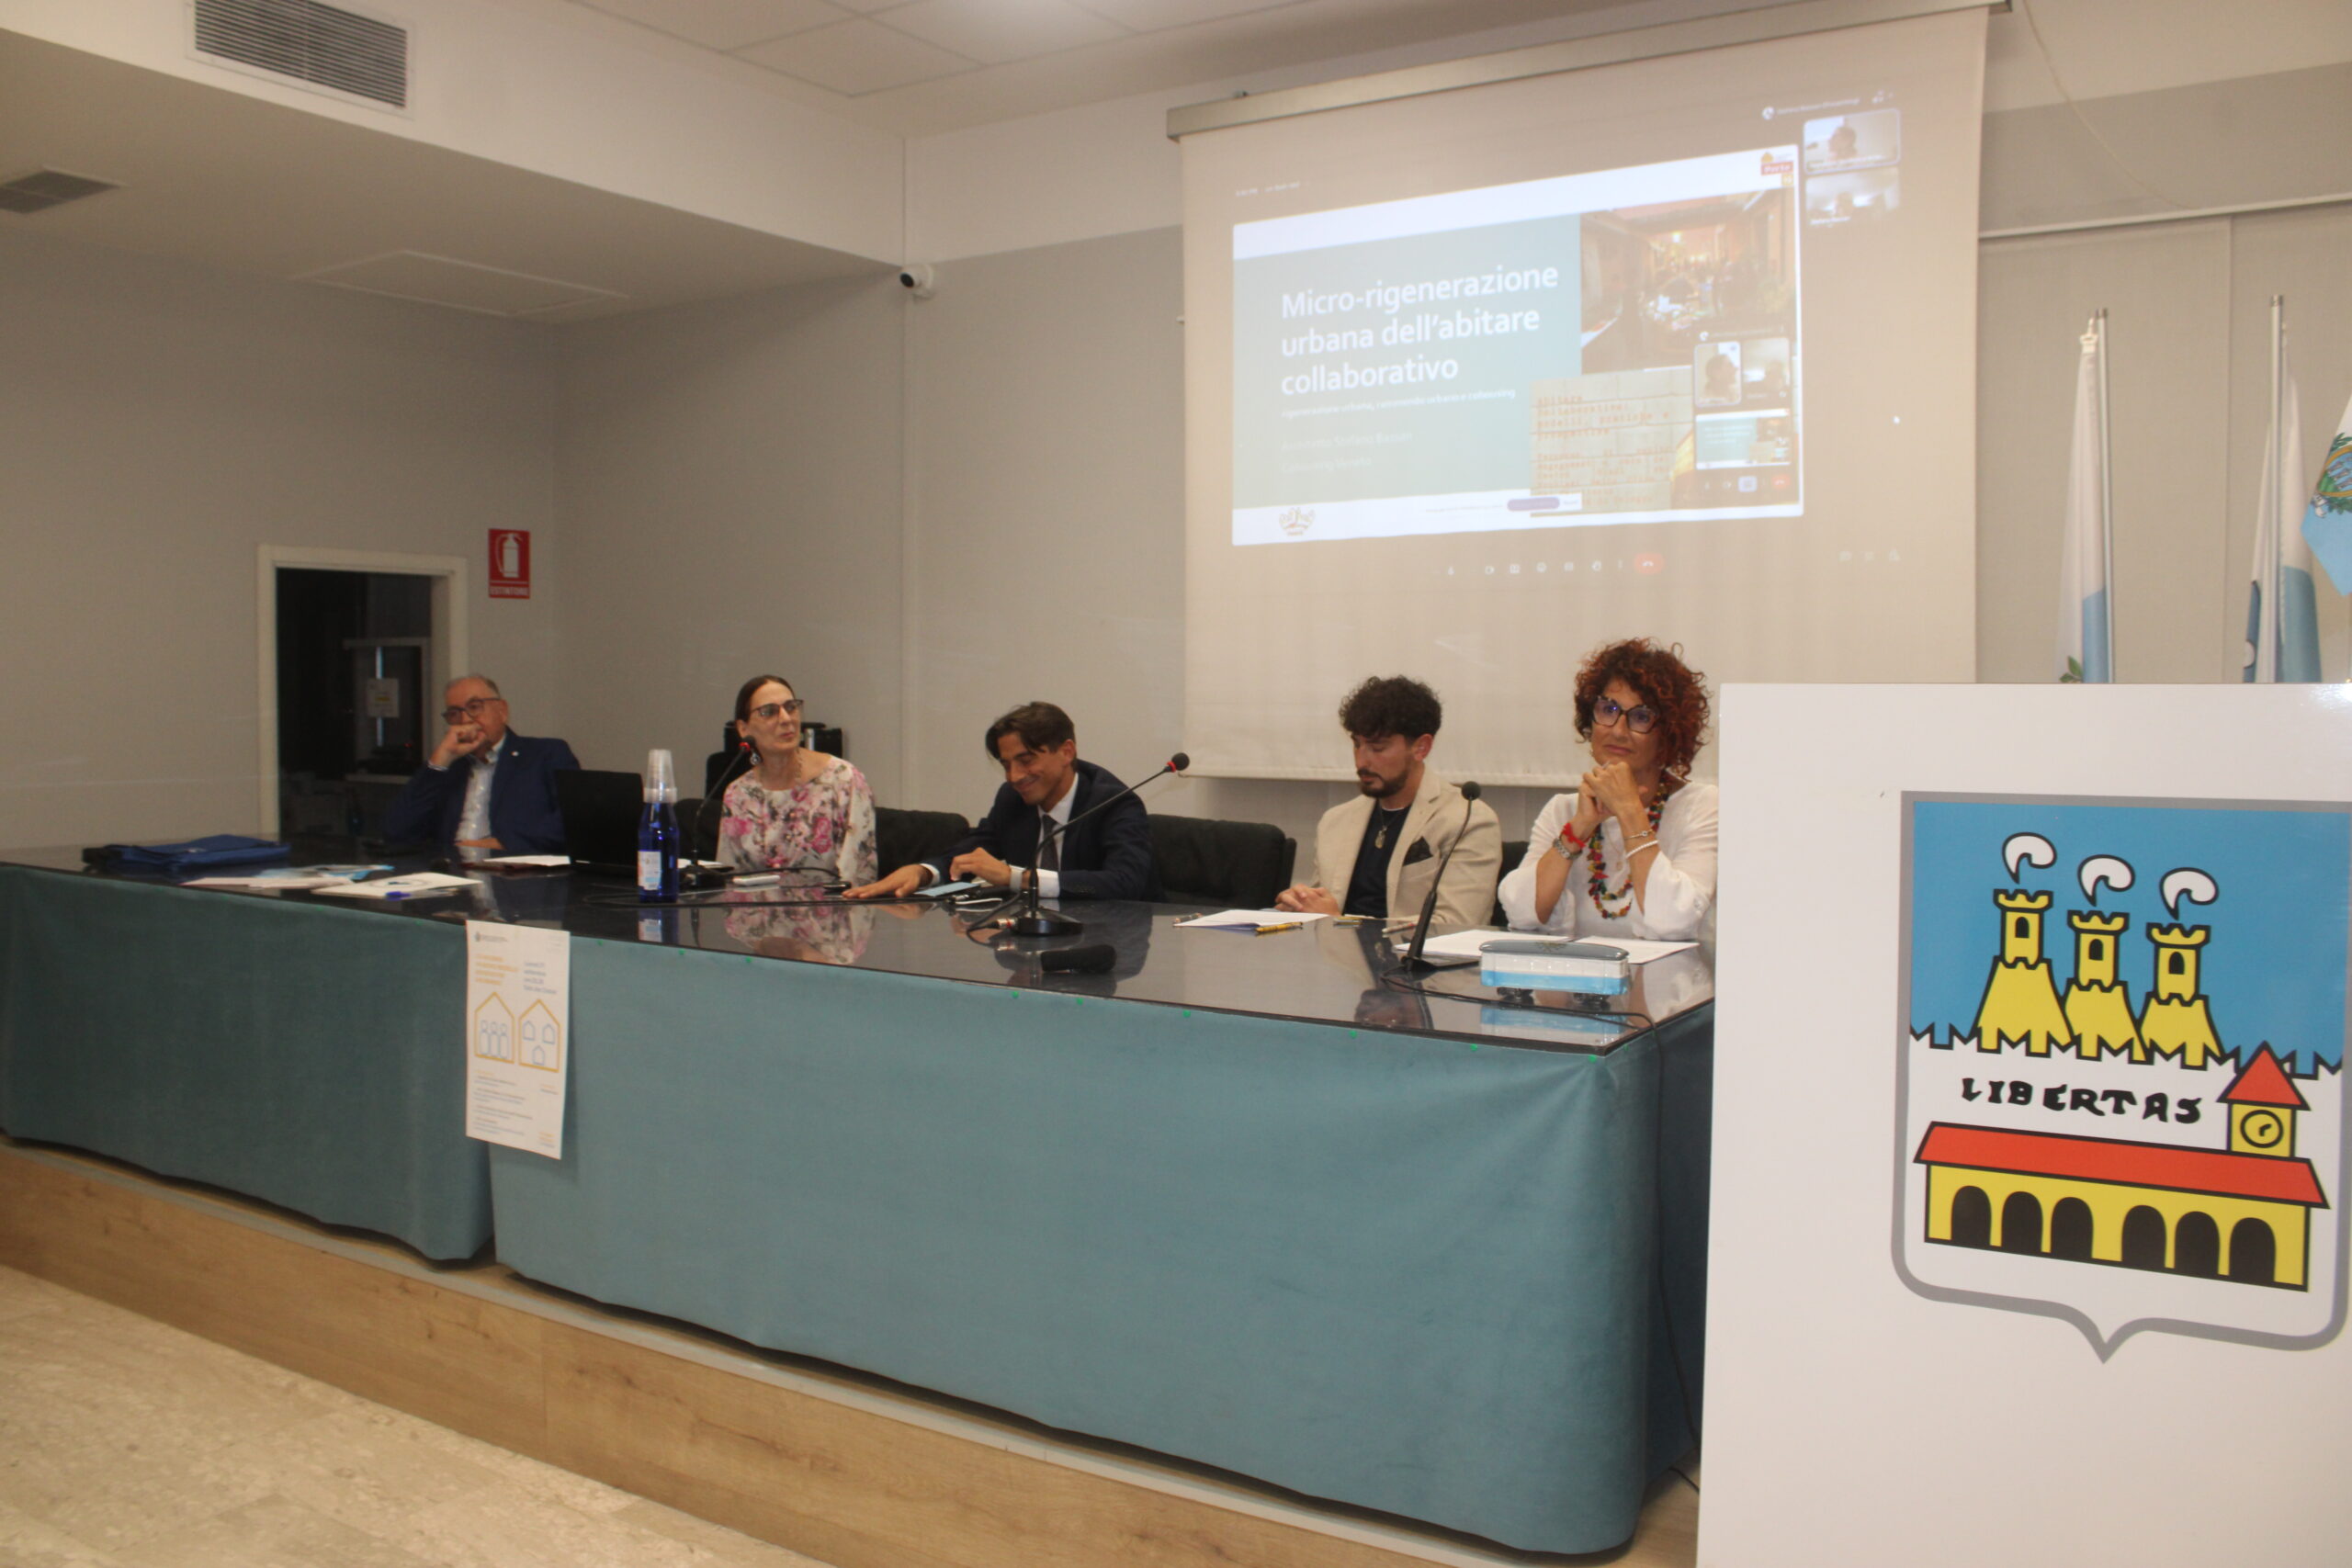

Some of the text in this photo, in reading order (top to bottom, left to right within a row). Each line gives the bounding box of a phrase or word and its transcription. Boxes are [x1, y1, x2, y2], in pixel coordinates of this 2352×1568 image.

[1282, 265, 1559, 318] Micro-rigenerazione
[1282, 308, 1541, 357] urbana dell'abitare
[1281, 354, 1459, 395] collaborativo
[1962, 1077, 2202, 1124] LIBERTAS
